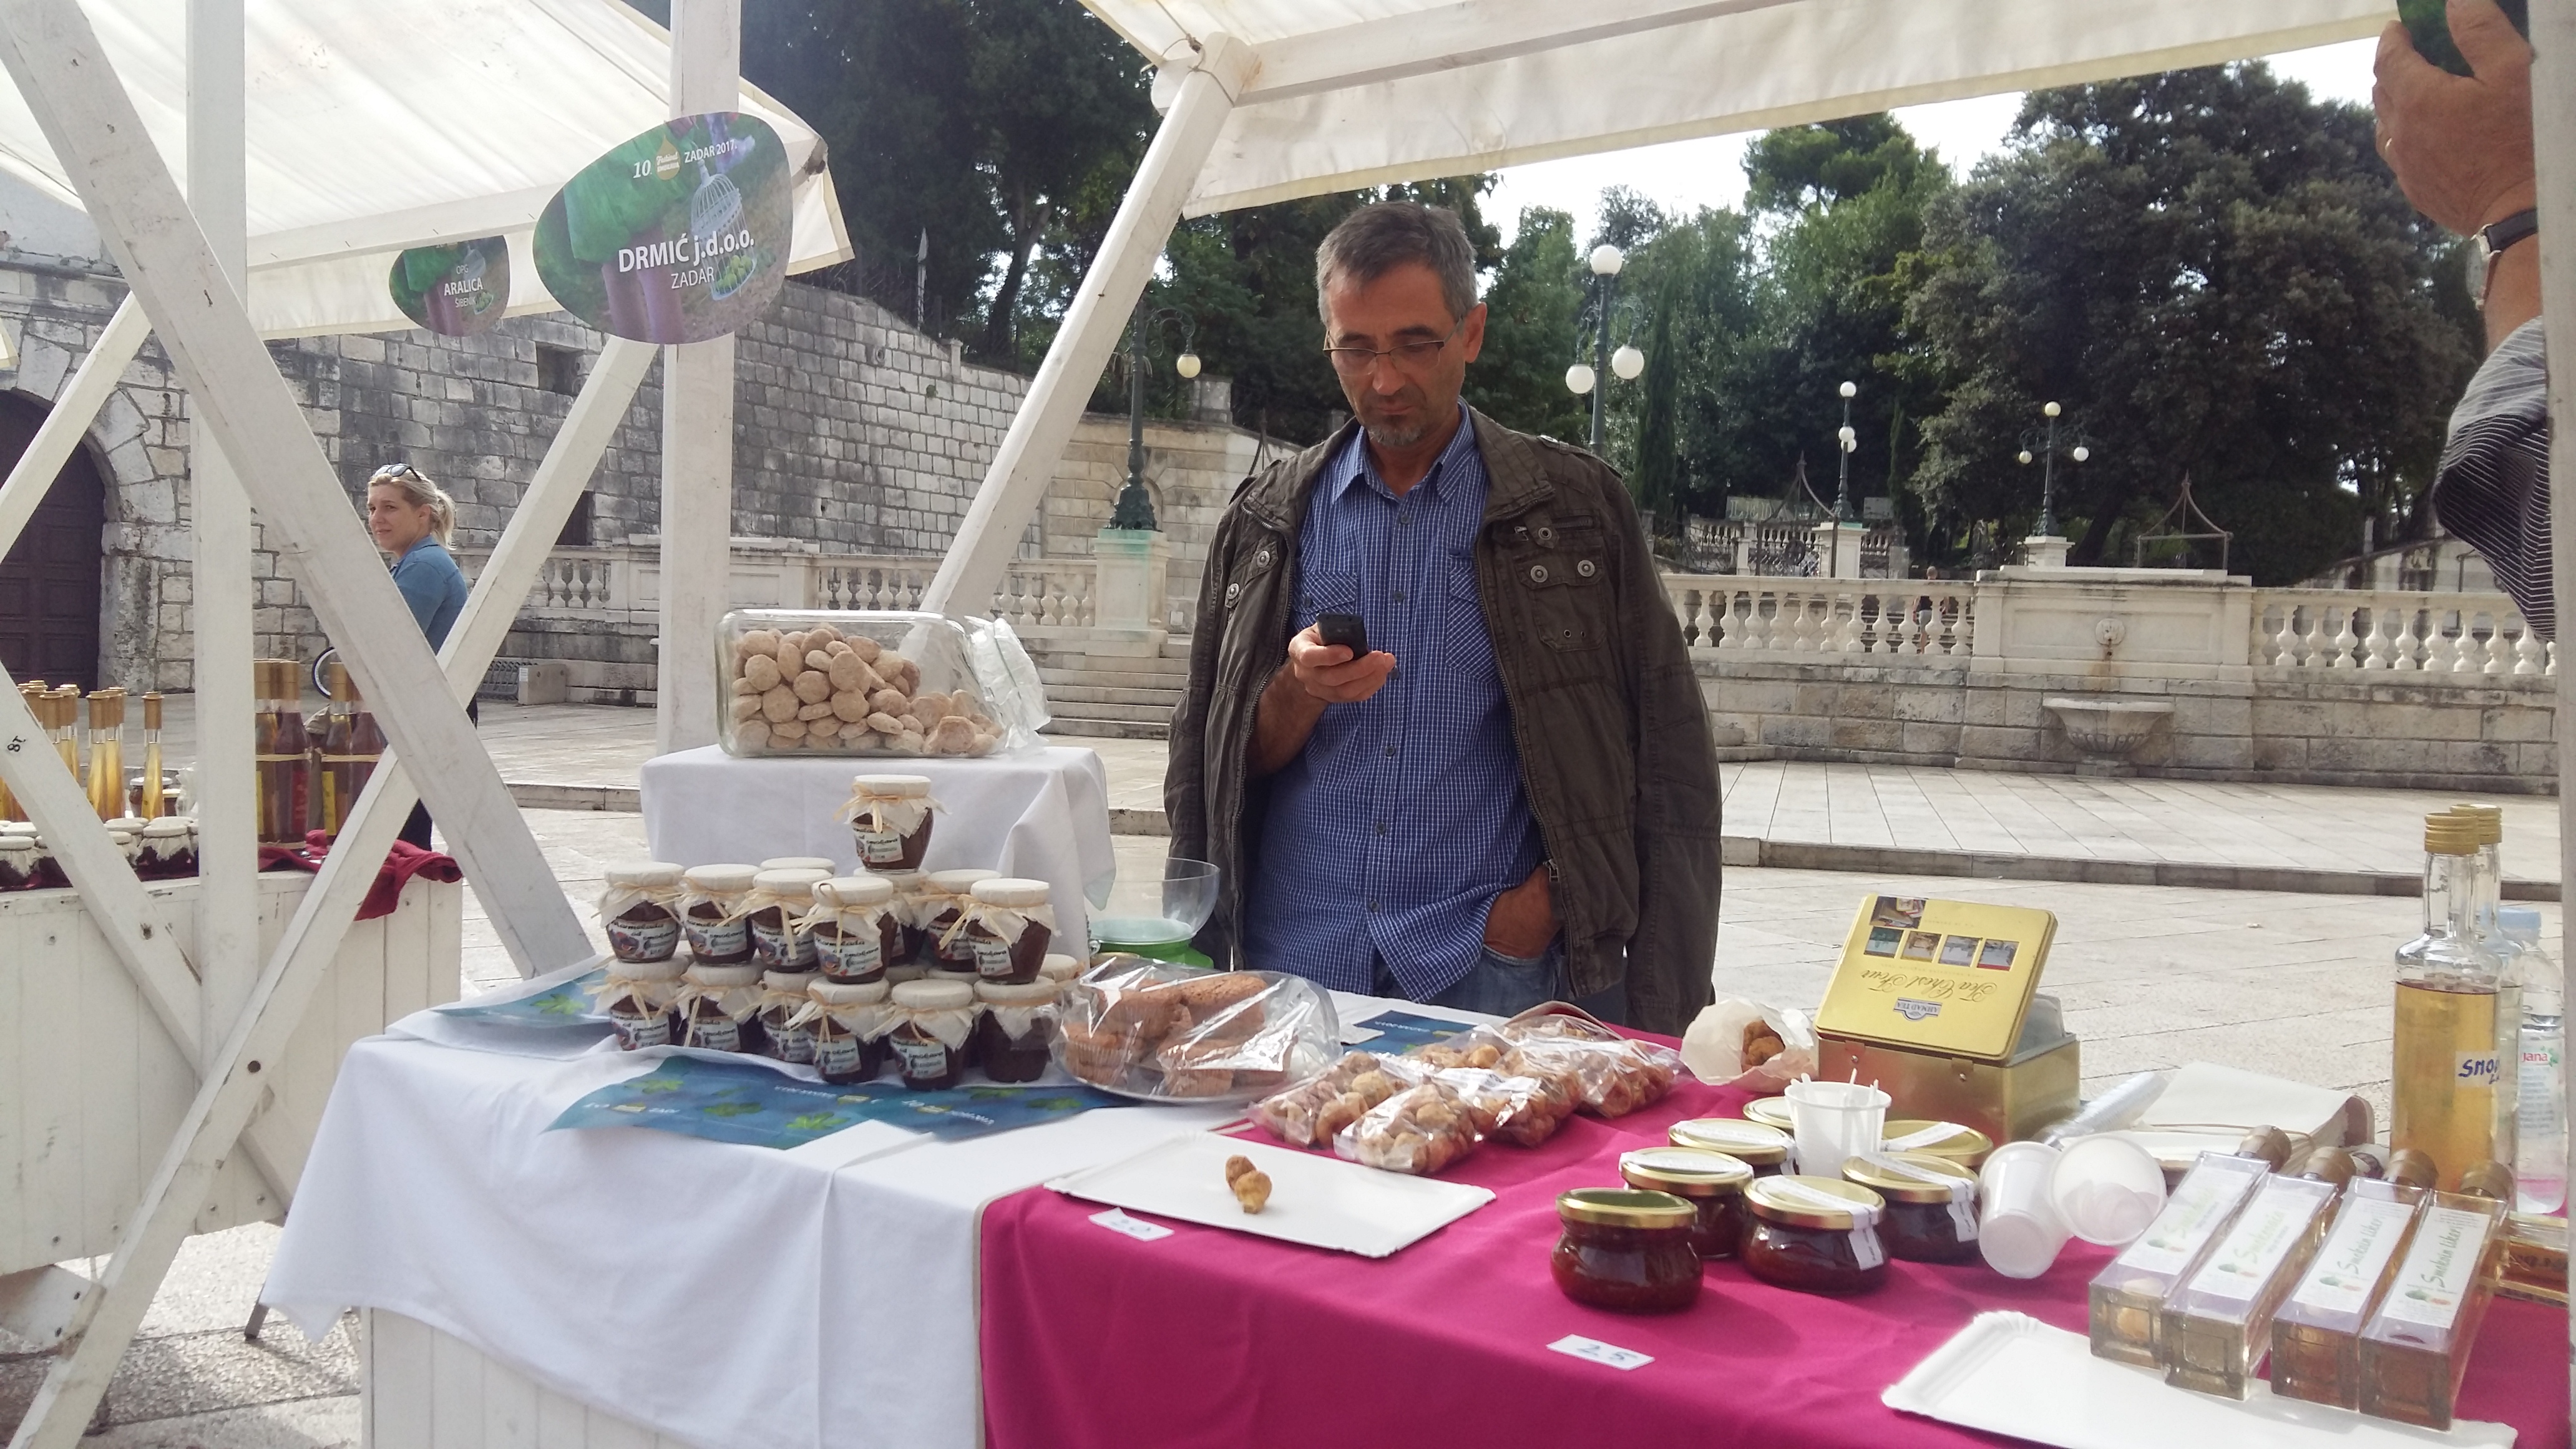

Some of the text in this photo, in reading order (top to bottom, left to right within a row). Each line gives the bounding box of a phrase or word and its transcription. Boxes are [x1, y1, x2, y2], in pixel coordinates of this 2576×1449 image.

[685, 140, 738, 163] ZADAR 2017.
[618, 229, 755, 273] DRMIĆ j.d.o.o.
[456, 264, 469, 275] OPG
[671, 266, 715, 290] ZADAR
[444, 277, 483, 296] ARALICA
[1861, 969, 1907, 993] Four
[1905, 975, 1955, 999] Chest
[1958, 982, 1997, 1002] Tea
[1897, 1001, 1910, 1010] TEA
